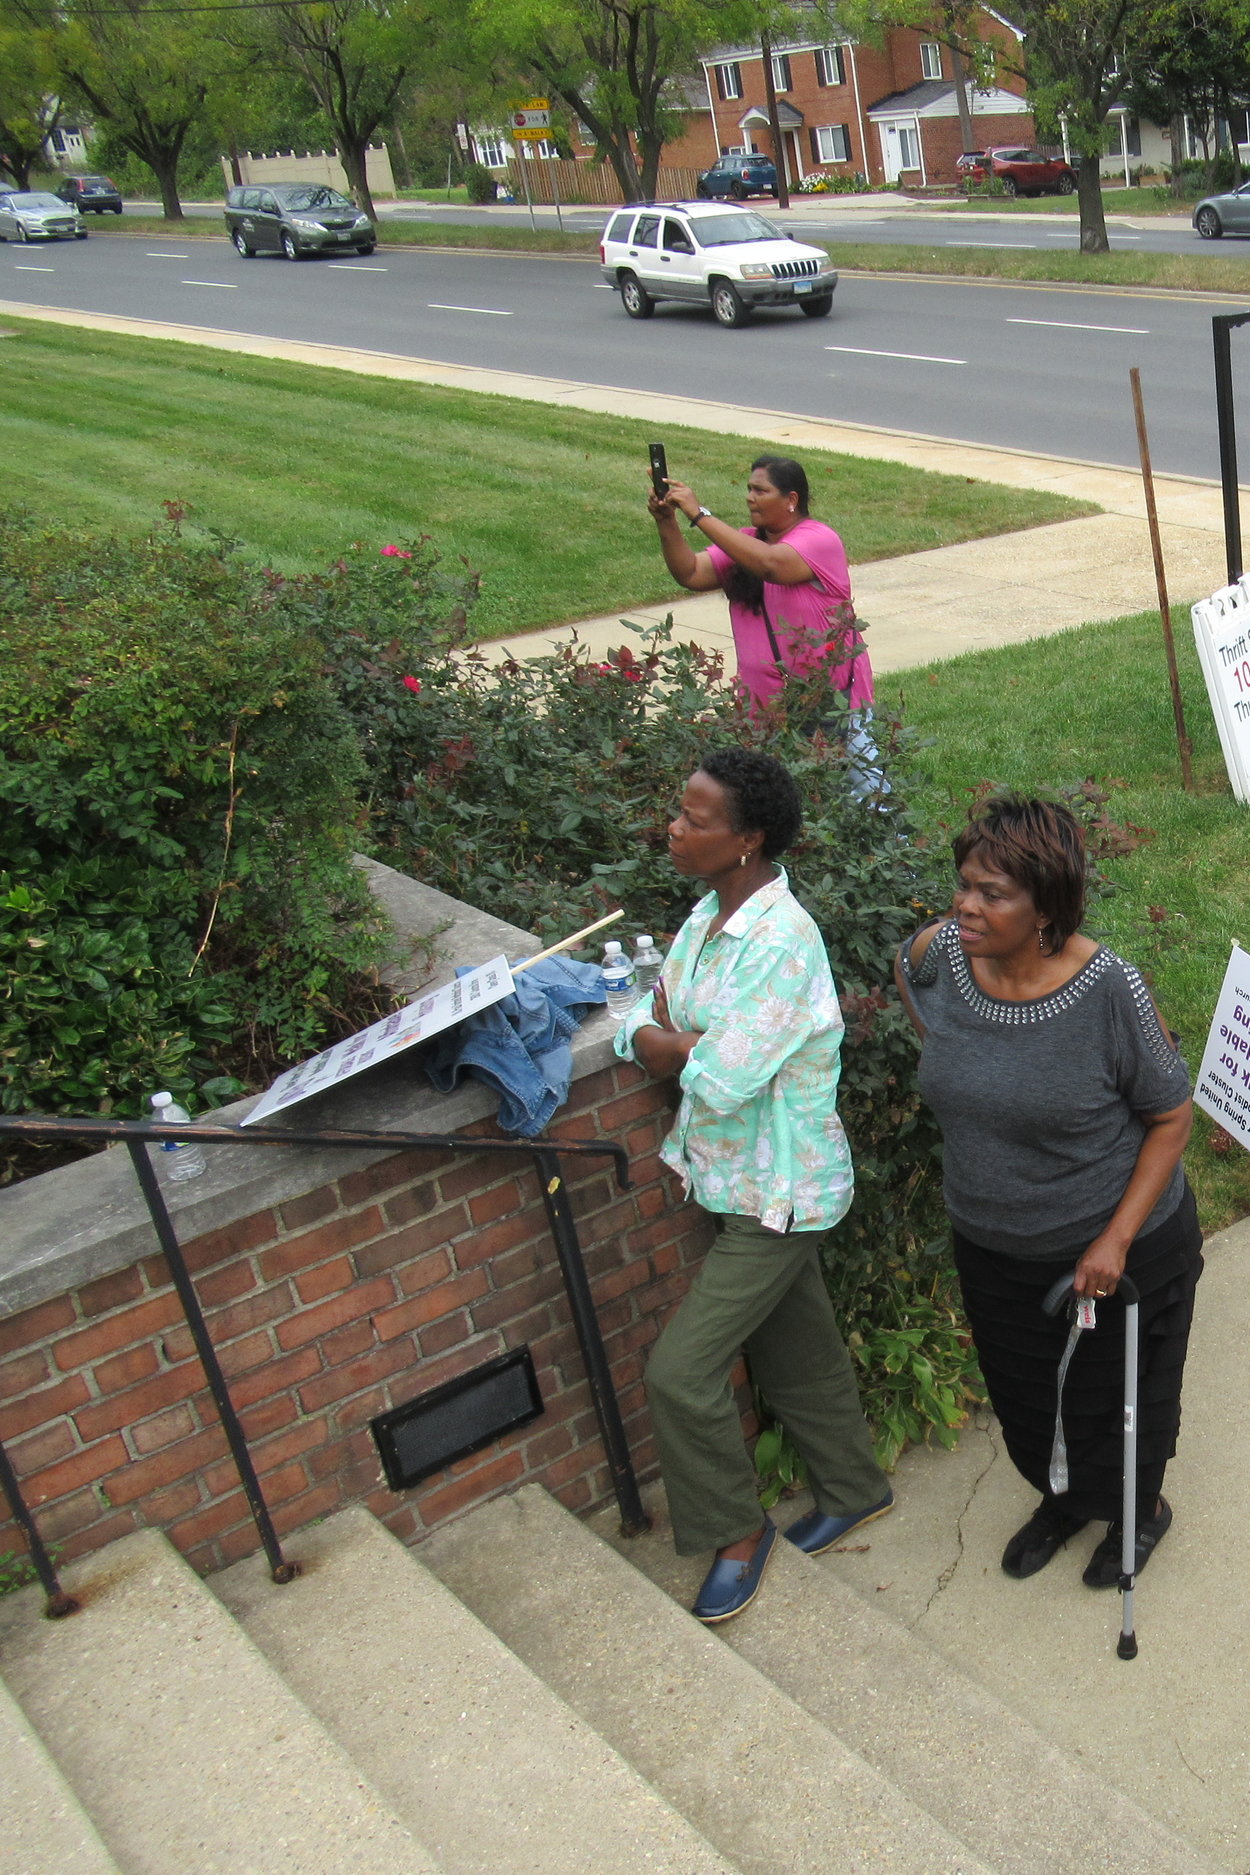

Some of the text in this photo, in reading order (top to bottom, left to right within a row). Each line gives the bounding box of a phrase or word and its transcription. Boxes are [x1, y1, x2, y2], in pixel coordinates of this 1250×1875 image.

[1219, 636, 1247, 667] Thrift
[1219, 1052, 1239, 1079] for
[1199, 1083, 1223, 1110] United
[1207, 1070, 1234, 1099] Cluster
[1222, 1102, 1248, 1135] Spring
